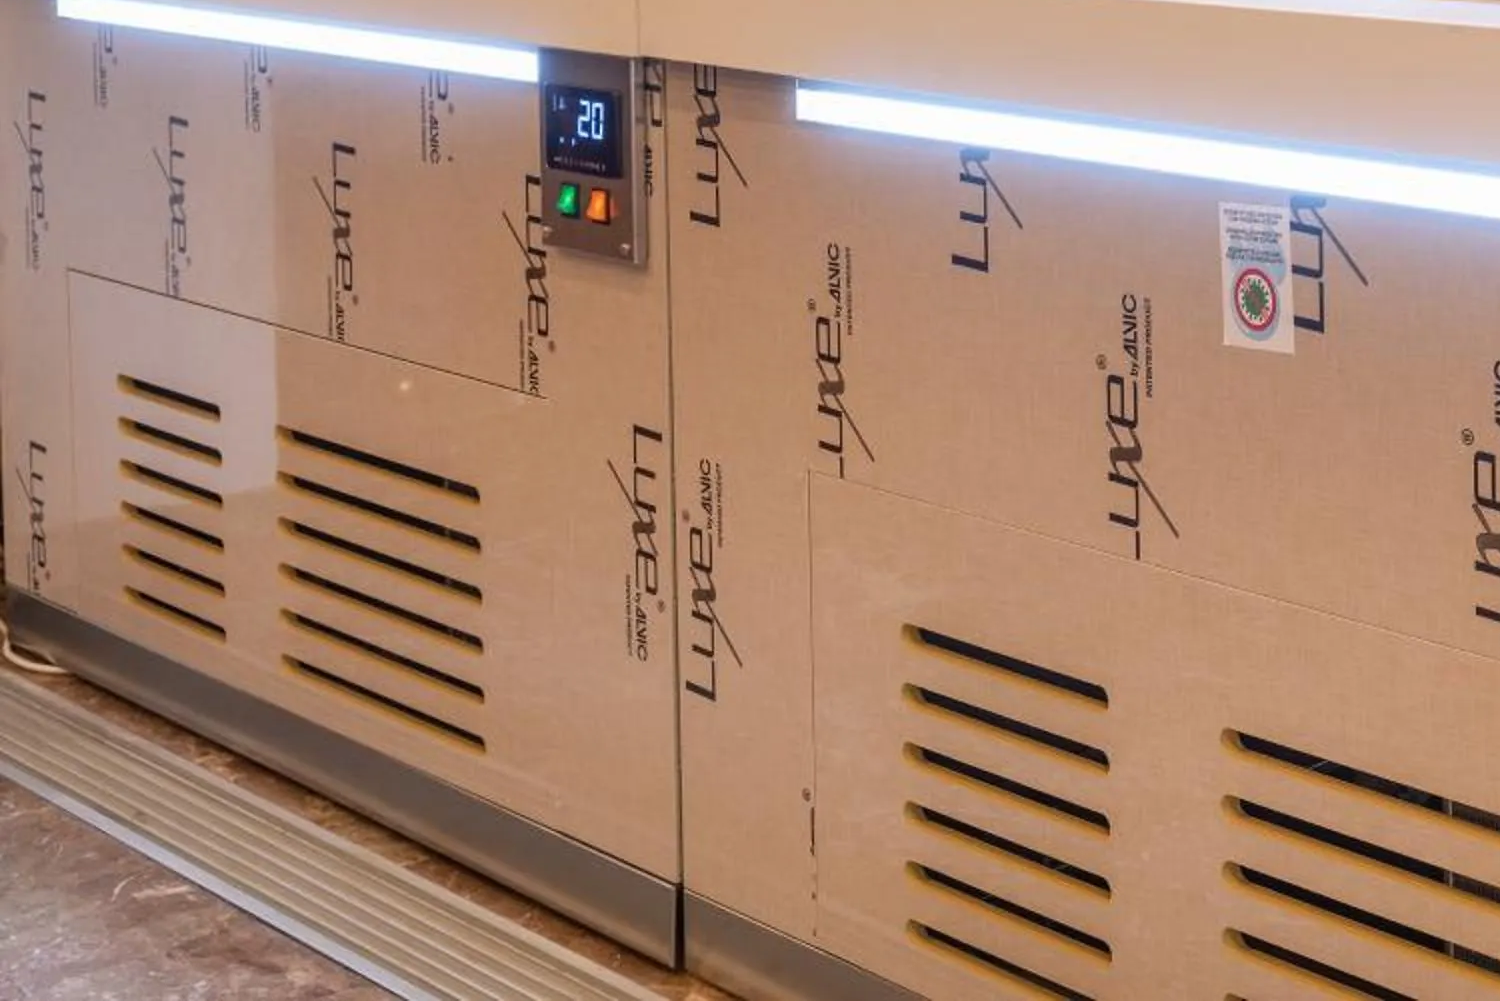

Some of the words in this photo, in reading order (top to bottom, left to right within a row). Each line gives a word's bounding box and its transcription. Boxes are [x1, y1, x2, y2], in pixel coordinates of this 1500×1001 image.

[577, 99, 605, 140] 20
[152, 115, 188, 254] Luxe
[312, 143, 356, 291] Luxe
[827, 243, 841, 304] ALVIC
[1122, 295, 1138, 361] ALVIC
[1130, 362, 1140, 377] by
[607, 424, 663, 596] Luxe
[700, 458, 712, 515] ALVIC
[635, 608, 648, 662] ALVIC
[685, 526, 742, 702] Luxe
